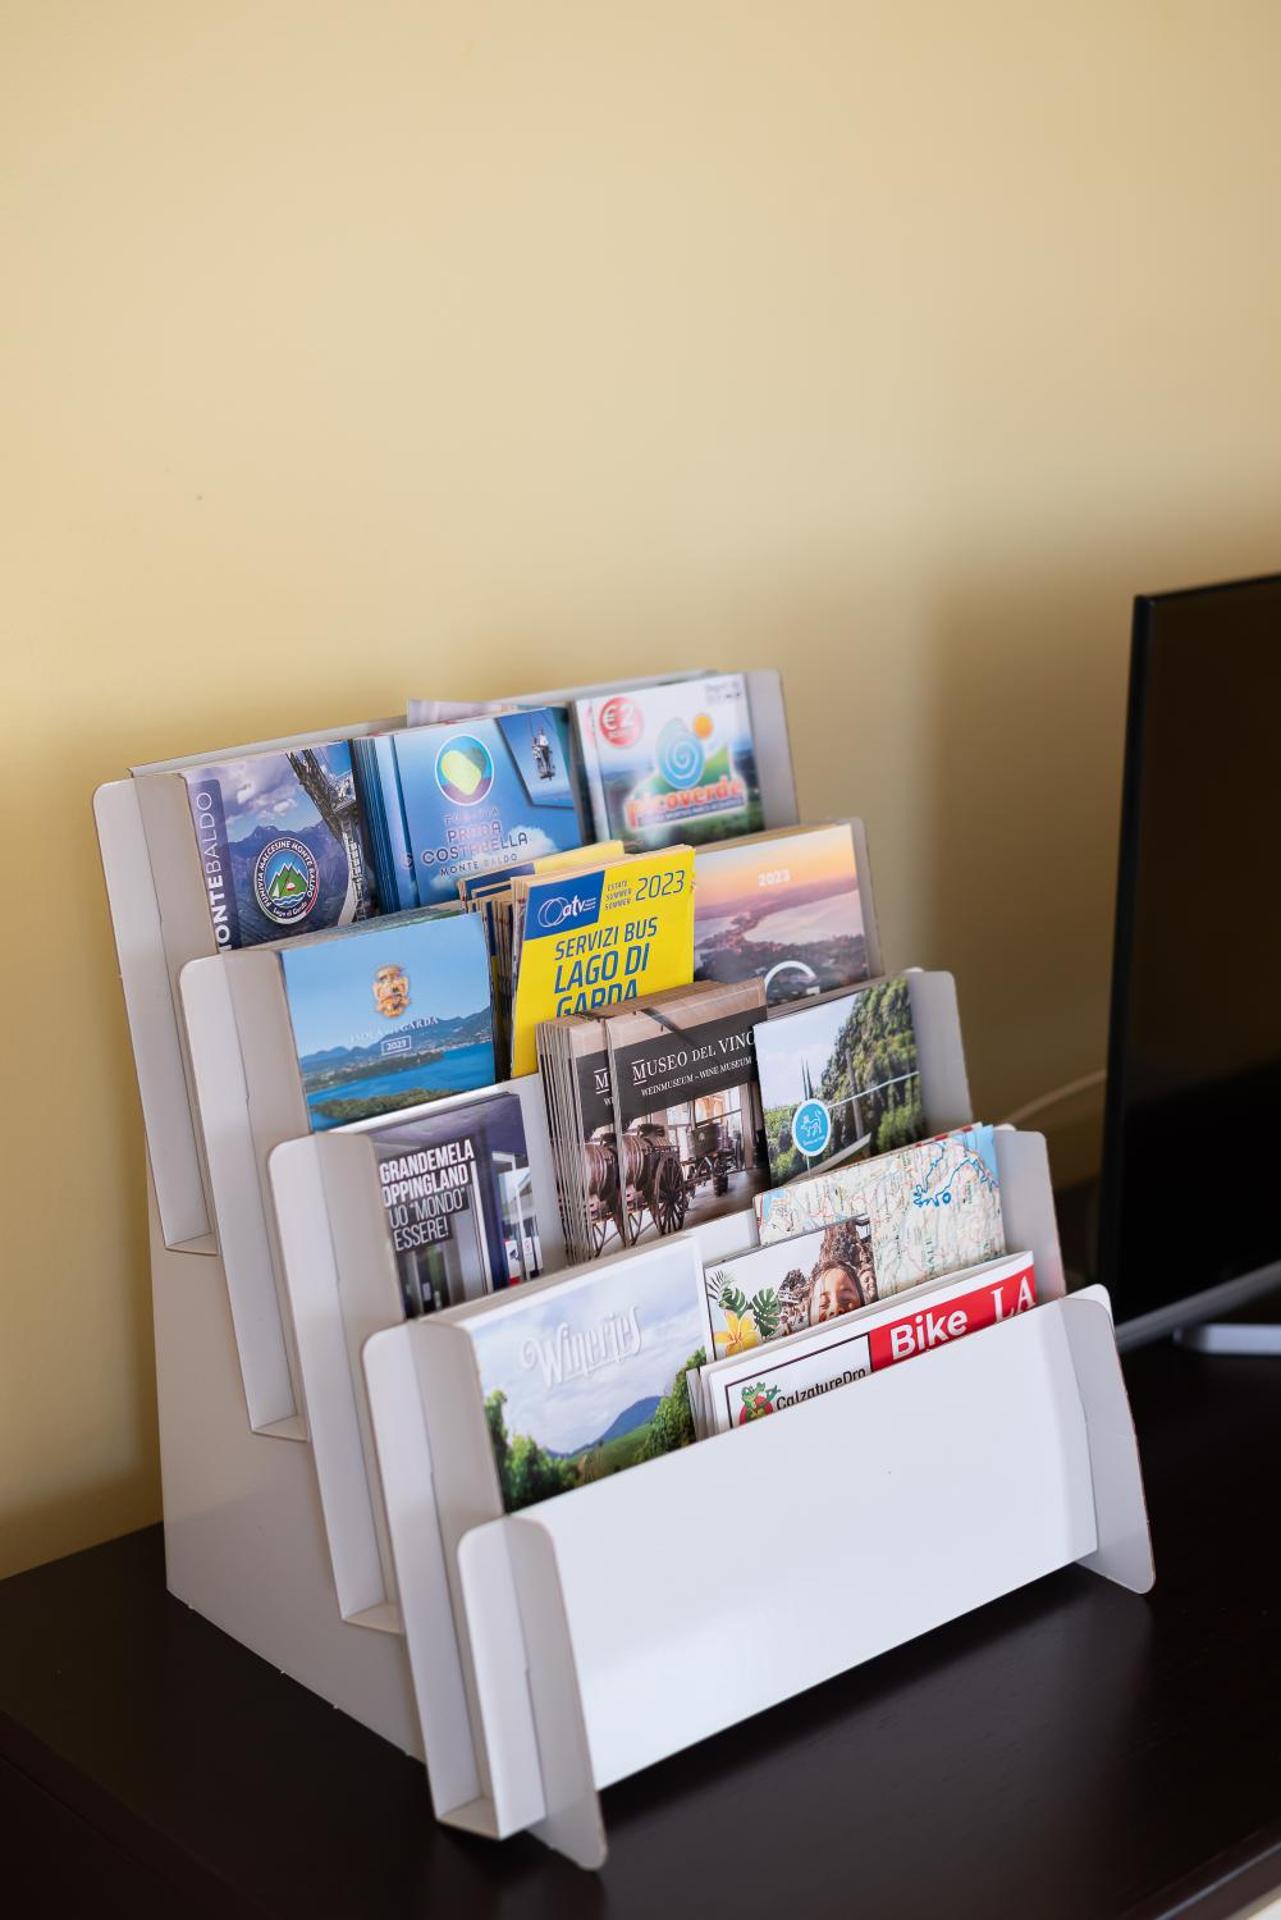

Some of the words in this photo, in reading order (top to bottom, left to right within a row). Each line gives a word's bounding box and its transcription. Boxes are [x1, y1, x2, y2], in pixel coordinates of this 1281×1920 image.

[197, 792, 232, 950] ONTEBALDO
[440, 861, 480, 877] MONTE
[636, 870, 685, 901] 2023
[757, 868, 790, 887] 2023
[554, 926, 619, 960] SERVIZI
[624, 917, 659, 942] BUS
[554, 951, 619, 994] LAGO
[624, 943, 650, 975] DI
[632, 1051, 688, 1082] MUSEO
[691, 1045, 717, 1062] DEL
[699, 1066, 719, 1079] WINE
[720, 1056, 752, 1072] MUSEUM
[380, 1139, 475, 1184] GRANDEMELA
[393, 1215, 449, 1251] ESSERE!
[890, 1307, 968, 1360] Bike
[991, 1275, 1036, 1325] LA
[521, 1304, 642, 1388] Wineries
